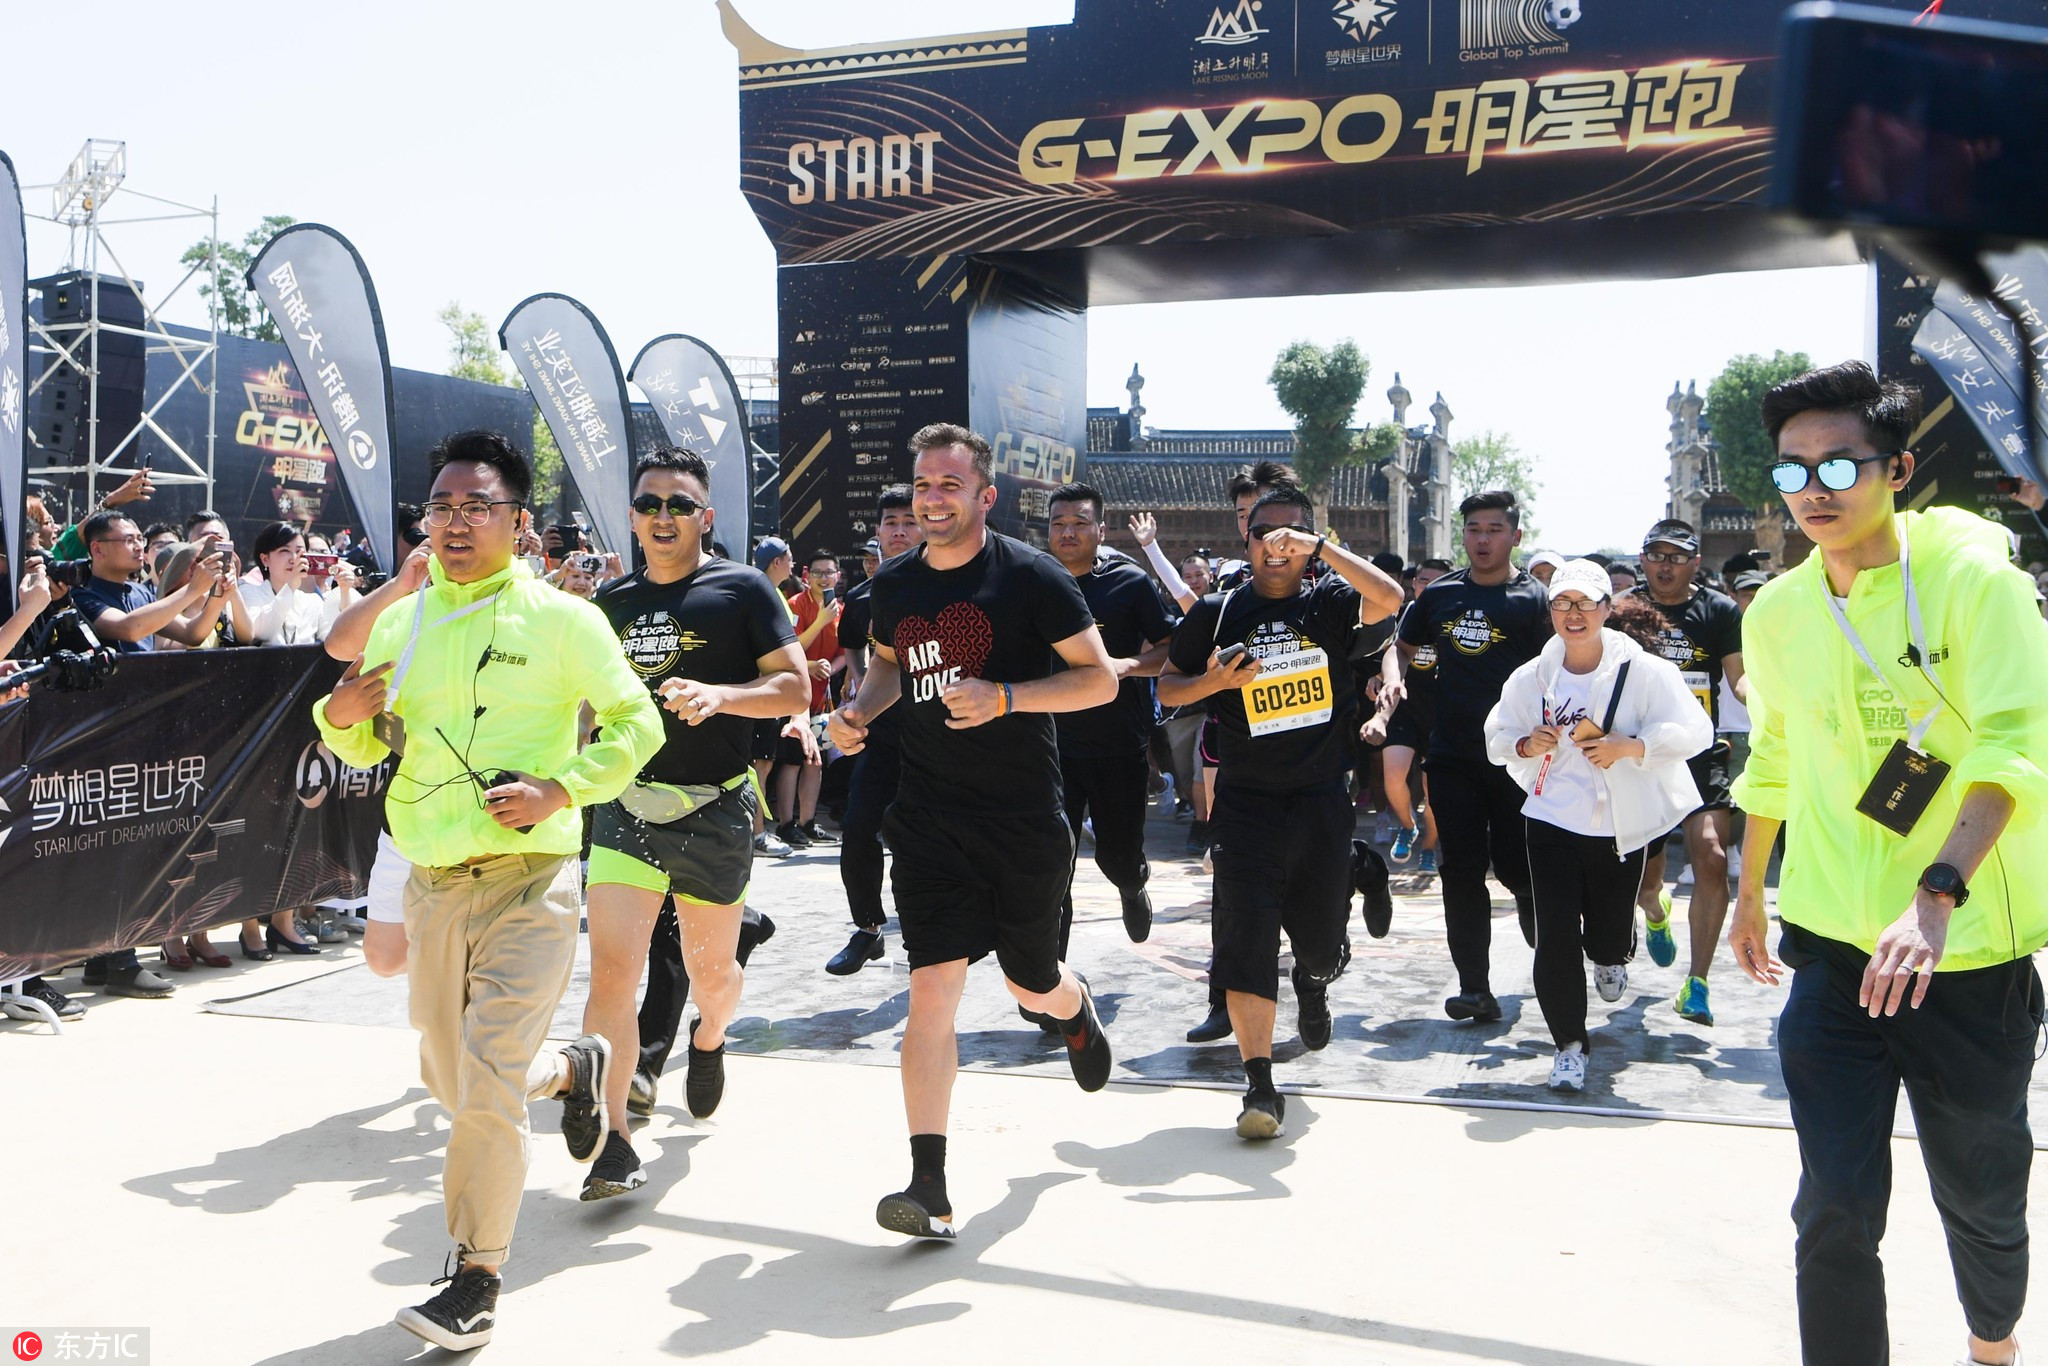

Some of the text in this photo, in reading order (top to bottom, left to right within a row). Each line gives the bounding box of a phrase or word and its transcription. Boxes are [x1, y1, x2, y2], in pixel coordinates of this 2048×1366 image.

[1325, 43, 1402, 66] 梦想星世界
[1459, 42, 1569, 62] Global Top Summit
[1192, 71, 1268, 85] LAKE RISING MOON
[1018, 61, 1745, 186] G-EXPO 明星跑
[788, 131, 941, 205] START
[993, 431, 1076, 485] G-EXPO
[629, 625, 673, 637] G-EXPO
[1253, 632, 1294, 644] G-EXPO
[908, 640, 943, 673] AIR
[1263, 660, 1289, 673] XPO
[28, 755, 206, 832] 梦想星世界
[34, 815, 203, 858] STARLIGHT DREAM WORLD
